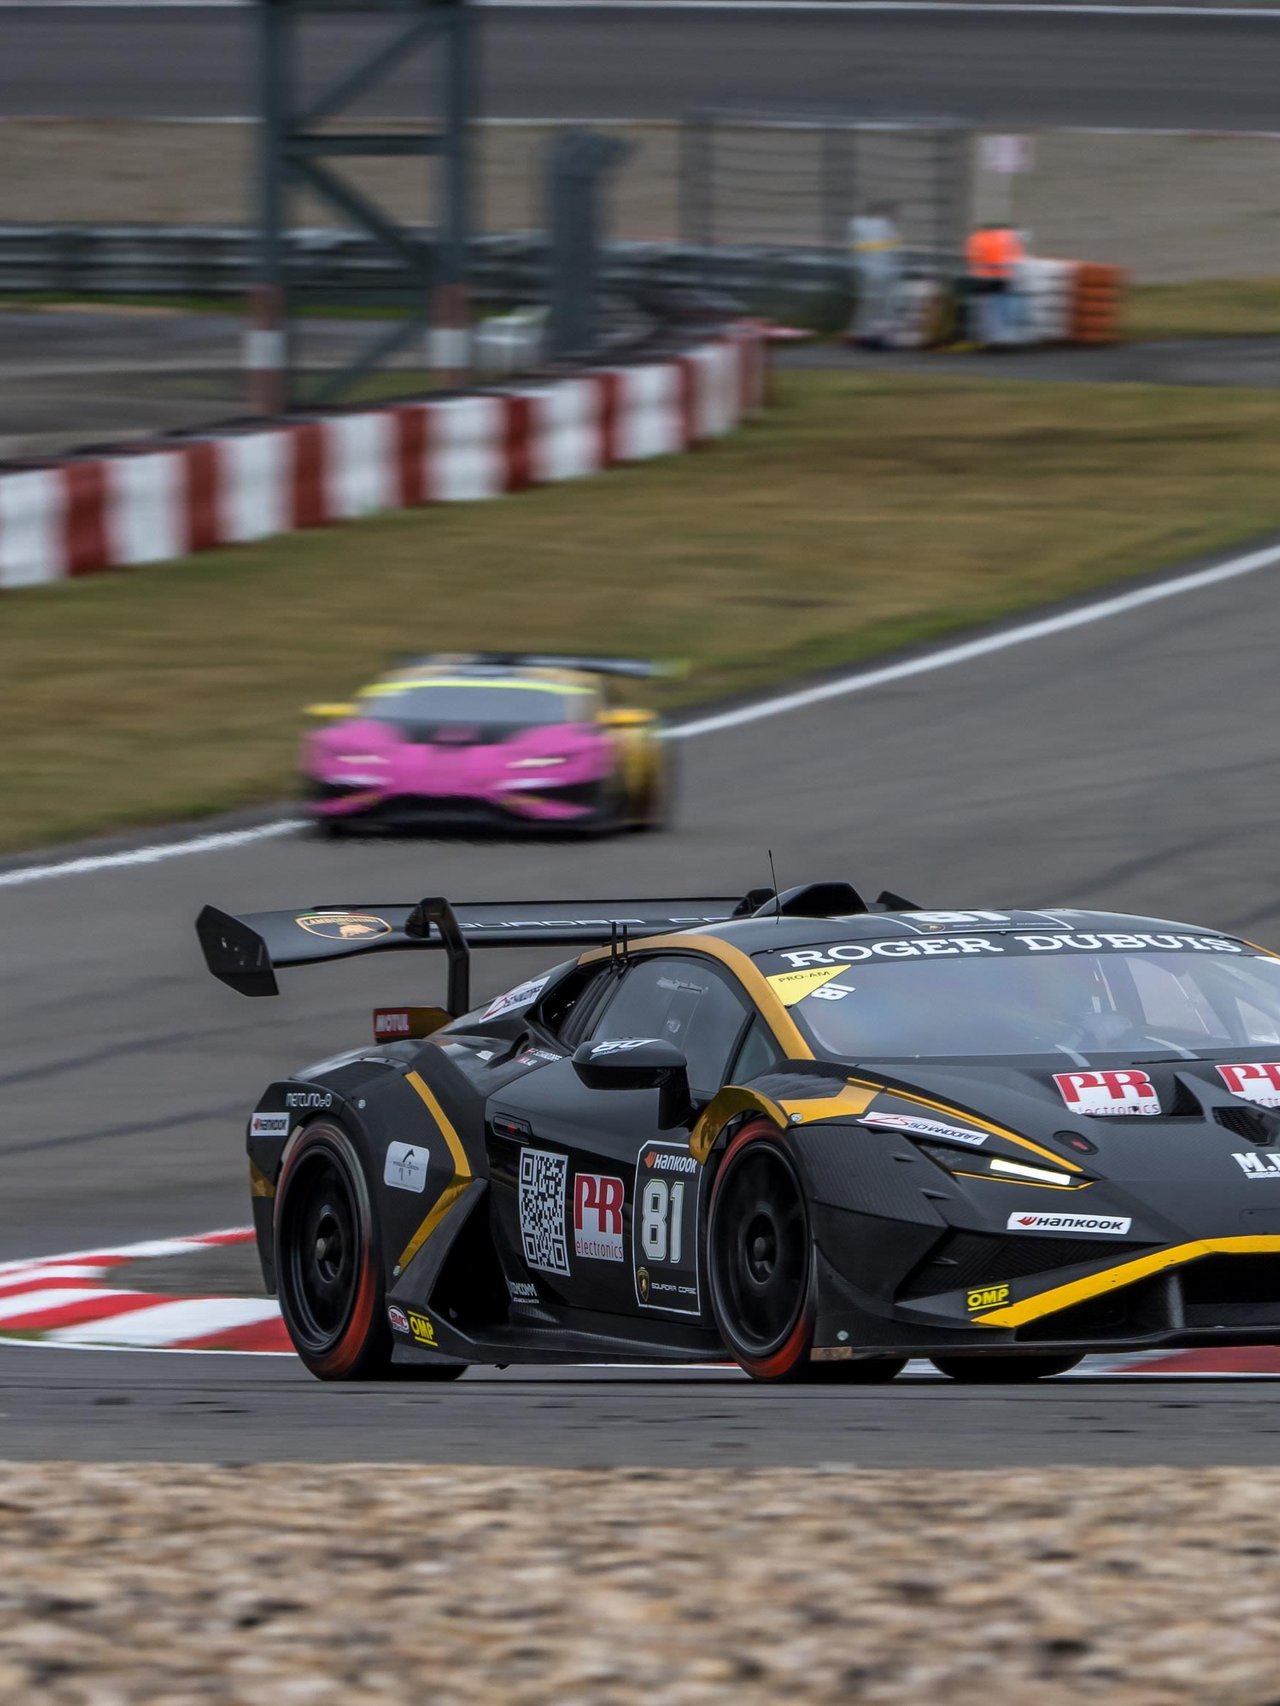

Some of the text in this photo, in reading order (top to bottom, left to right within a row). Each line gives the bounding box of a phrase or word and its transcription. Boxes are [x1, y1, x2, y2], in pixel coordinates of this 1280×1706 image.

[781, 934, 1242, 967] ROGER DUBUIS
[778, 970, 831, 983] PRO-AM
[810, 982, 856, 1001] 81
[376, 1013, 409, 1032] MOTUL
[1056, 1071, 1154, 1102] PR
[907, 1121, 984, 1141] SCHANDORFF
[575, 1175, 624, 1235] PR
[642, 1178, 684, 1264] 81
[576, 1238, 623, 1260] electronics
[967, 1288, 1010, 1307] OMP
[410, 1316, 434, 1340] OMP
